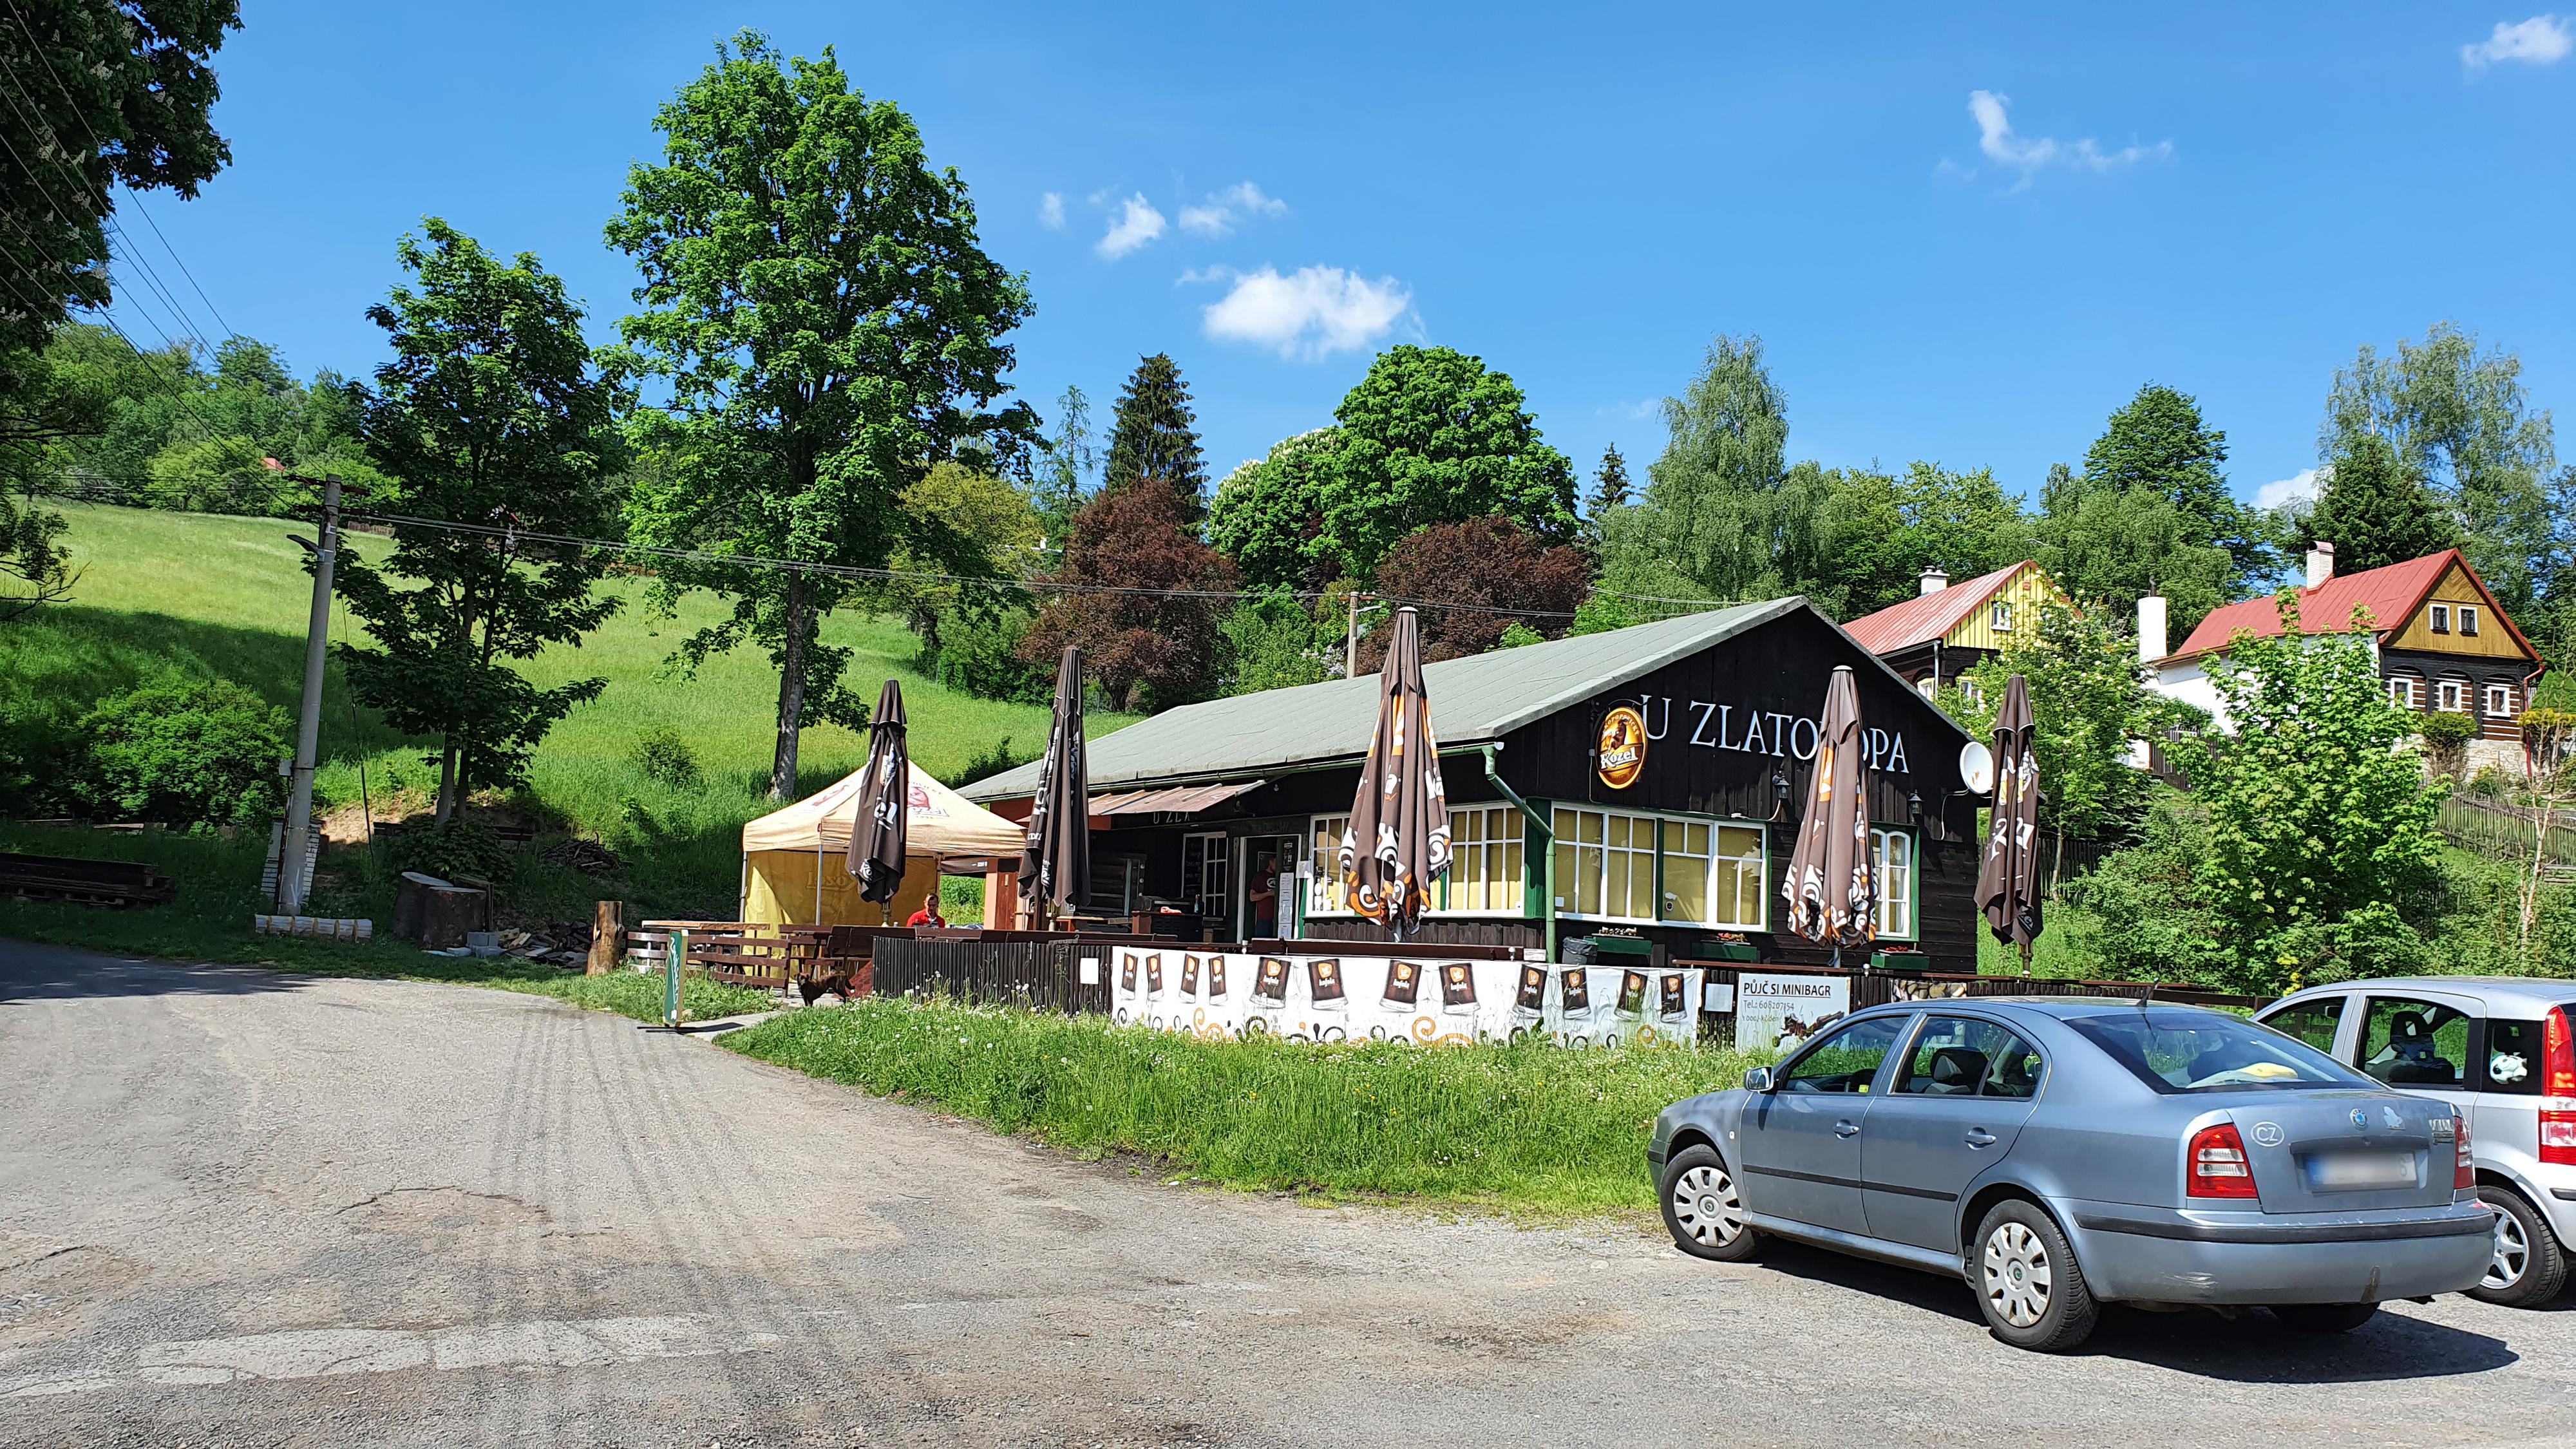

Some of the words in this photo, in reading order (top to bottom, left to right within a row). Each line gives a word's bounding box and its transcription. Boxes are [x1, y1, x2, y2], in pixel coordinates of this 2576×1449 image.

[1640, 694, 1672, 740] U
[1689, 700, 1909, 773] ZLATOPA
[1600, 746, 1639, 770] Kozel
[1743, 978, 1768, 995] PŮJČ
[1771, 983, 1779, 995] SI
[1782, 983, 1831, 996] MINIBAGR
[2256, 1126, 2278, 1142] CZ
